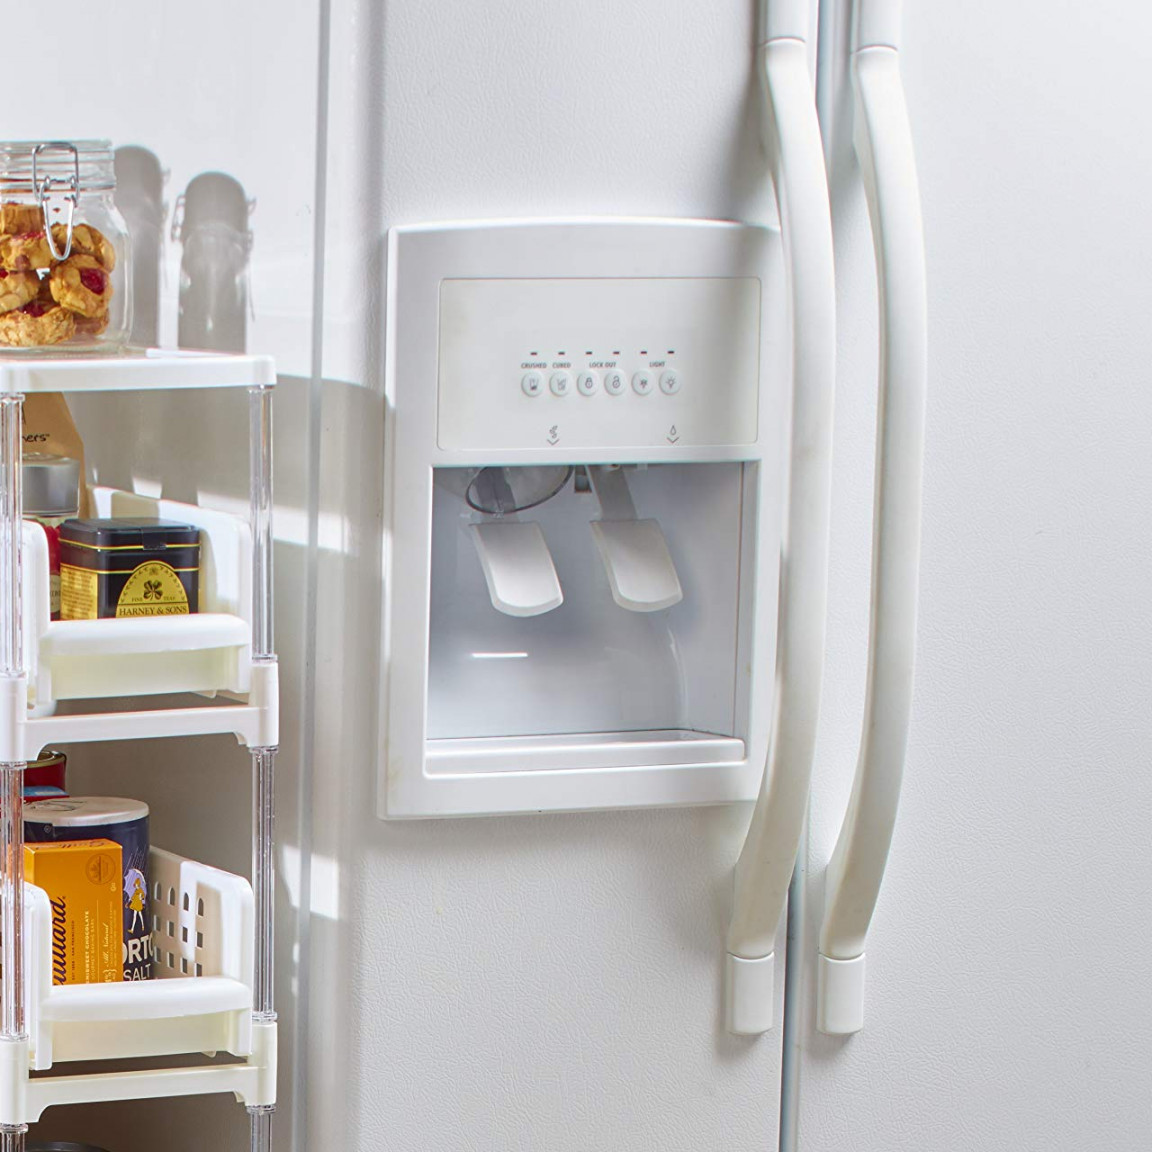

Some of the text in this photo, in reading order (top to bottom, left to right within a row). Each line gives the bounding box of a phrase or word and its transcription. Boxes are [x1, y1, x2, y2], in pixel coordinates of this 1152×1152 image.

[119, 605, 187, 616] HARNEY & SONS
[123, 963, 151, 981] SALT
